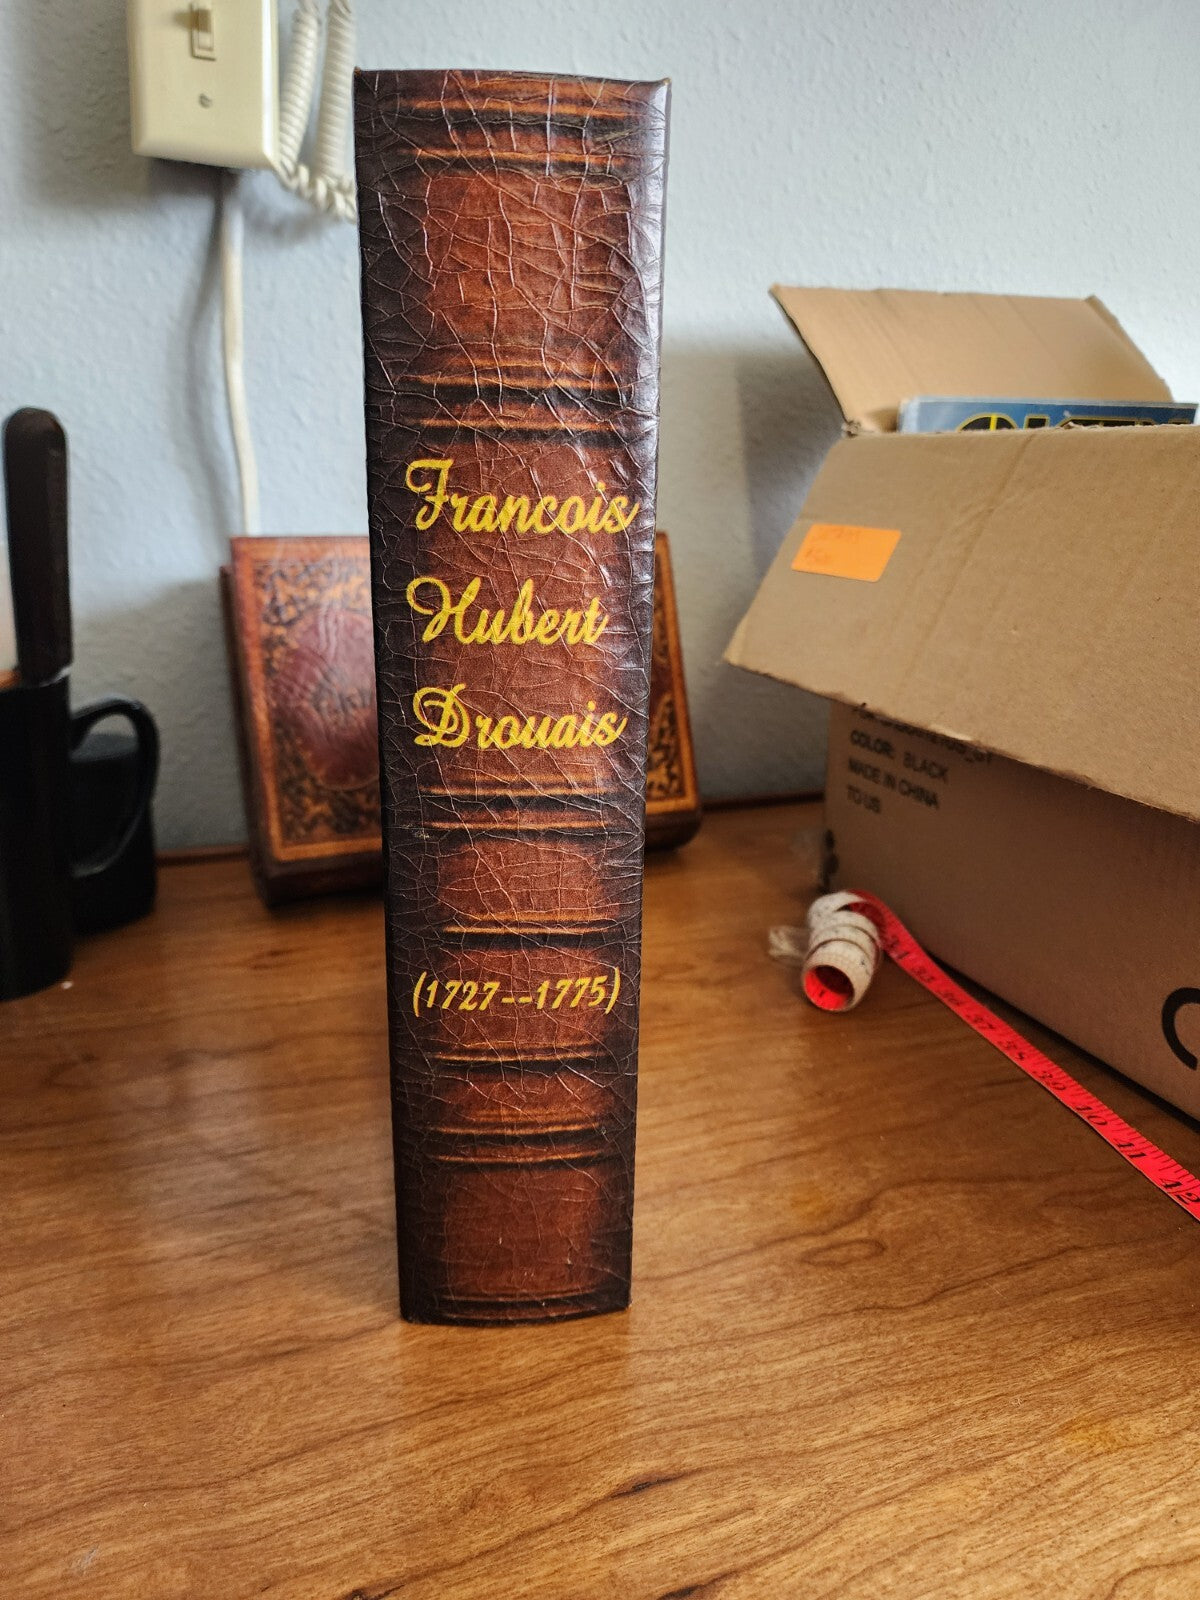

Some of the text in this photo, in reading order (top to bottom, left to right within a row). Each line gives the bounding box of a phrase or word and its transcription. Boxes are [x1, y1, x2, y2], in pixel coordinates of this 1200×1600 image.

[405, 458, 640, 535] Francois
[406, 576, 610, 645] Hubert
[412, 683, 629, 750] Drouais
[848, 757, 881, 785] MADE
[898, 779, 940, 810] CHINA
[903, 751, 949, 784] BLACK
